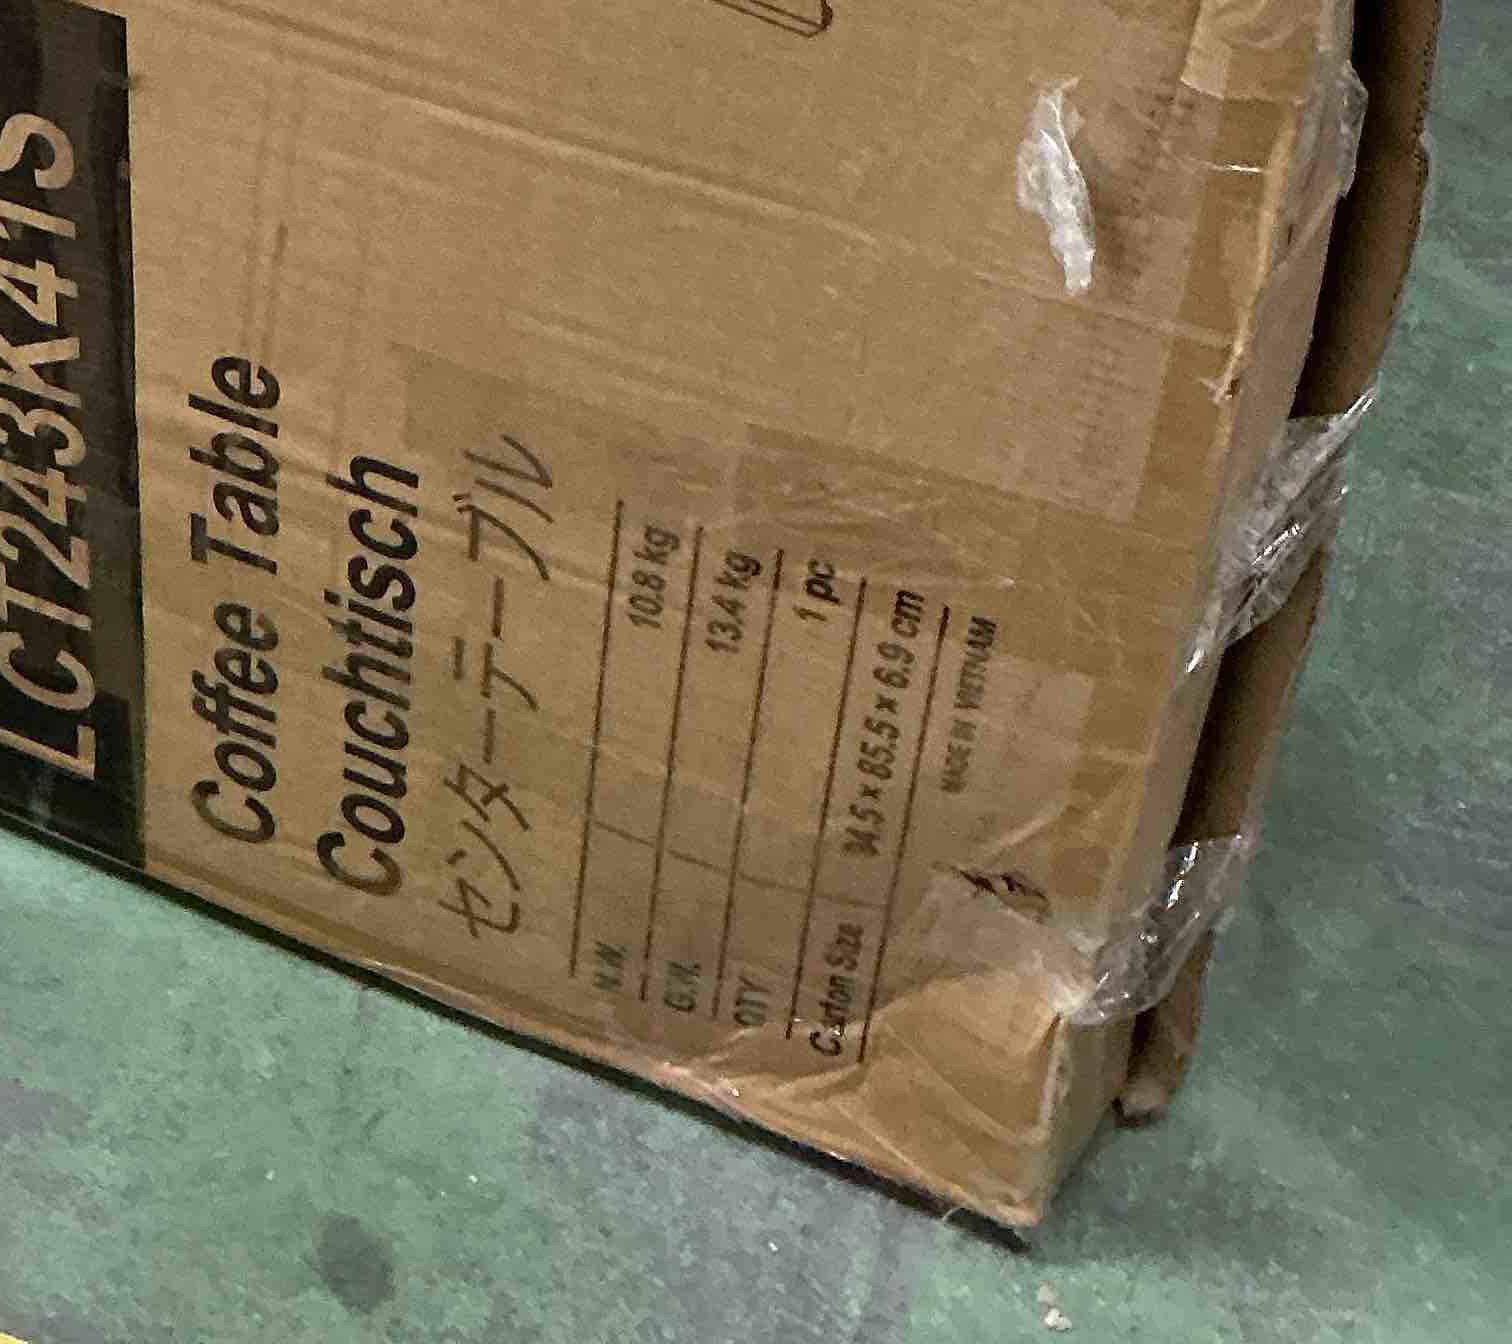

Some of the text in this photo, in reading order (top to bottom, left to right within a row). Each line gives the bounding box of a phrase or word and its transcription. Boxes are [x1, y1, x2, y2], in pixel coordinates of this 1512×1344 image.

[190, 353, 281, 844] Coffee Table
[628, 525, 681, 630] 10.8 kg
[705, 550, 762, 653] 13.4 kg
[792, 558, 842, 623] 1 pc
[890, 588, 926, 639] cm
[316, 453, 421, 896] Couchtisch
[438, 434, 554, 938] センターテーブル
[872, 640, 916, 690] 6.9
[857, 715, 901, 780] 85.5
